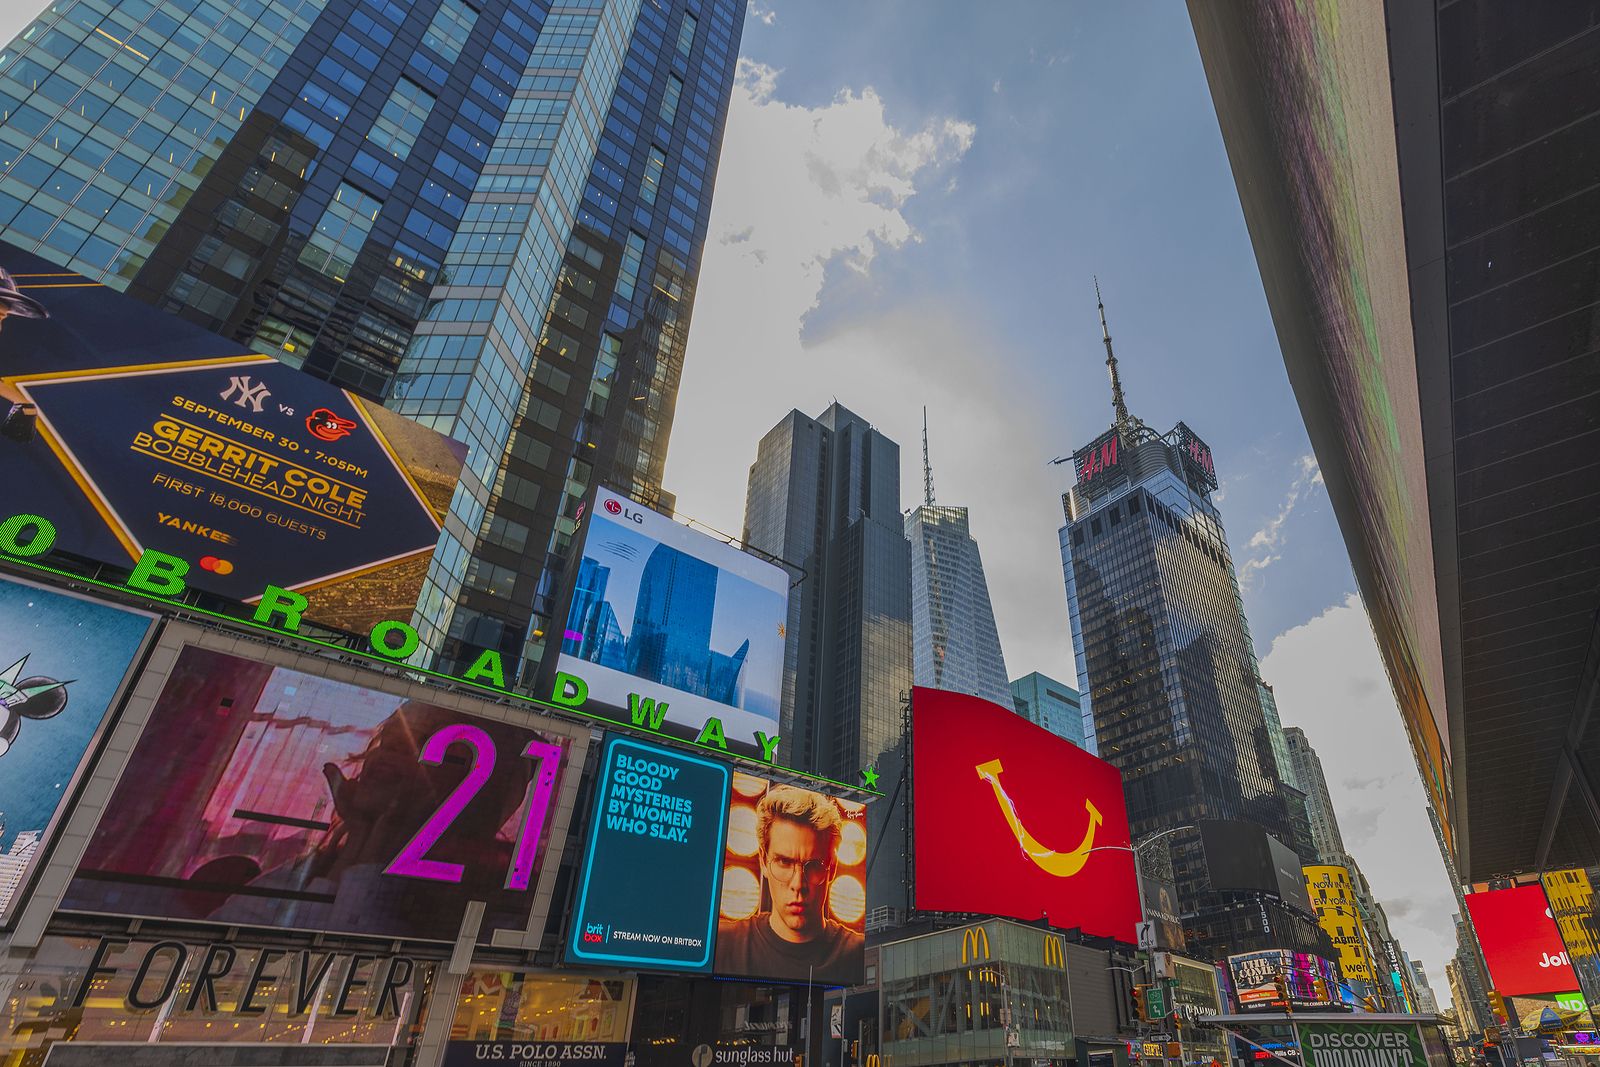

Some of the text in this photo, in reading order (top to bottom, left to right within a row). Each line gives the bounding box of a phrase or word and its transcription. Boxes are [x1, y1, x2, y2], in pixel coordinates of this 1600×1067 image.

[171, 395, 368, 479] SEPTEMBER 30 7:05PM
[153, 420, 366, 509] GERRIT COLE
[1080, 434, 1117, 484] H&M
[133, 431, 366, 523] BOBBLEHEAD NIGHT
[152, 472, 327, 540] FIRST 18,000 GUESTS
[624, 508, 643, 524] LG
[616, 754, 679, 781] BLOODY
[614, 769, 662, 791] GOOD
[383, 723, 562, 890] 21
[611, 784, 692, 812] MYSTERIES
[608, 799, 692, 828] BY WOMEN
[606, 814, 688, 843] WHO SLAY.
[1313, 881, 1333, 889] NOW
[586, 922, 603, 934] brit
[1260, 904, 1270, 933] 1500
[584, 931, 603, 943] box
[613, 931, 702, 947] STREAM NOW ON BRITBOX
[1140, 940, 1154, 948] ONLY
[1239, 965, 1276, 979] COME
[1241, 958, 1269, 969] THE
[72, 936, 415, 1018] FOREVER
[1247, 975, 1264, 985] UP
[1309, 1033, 1409, 1048] DISCOVER
[475, 1044, 607, 1060] U.S. POLO ASSN.
[715, 1046, 794, 1067] sunglass hut
